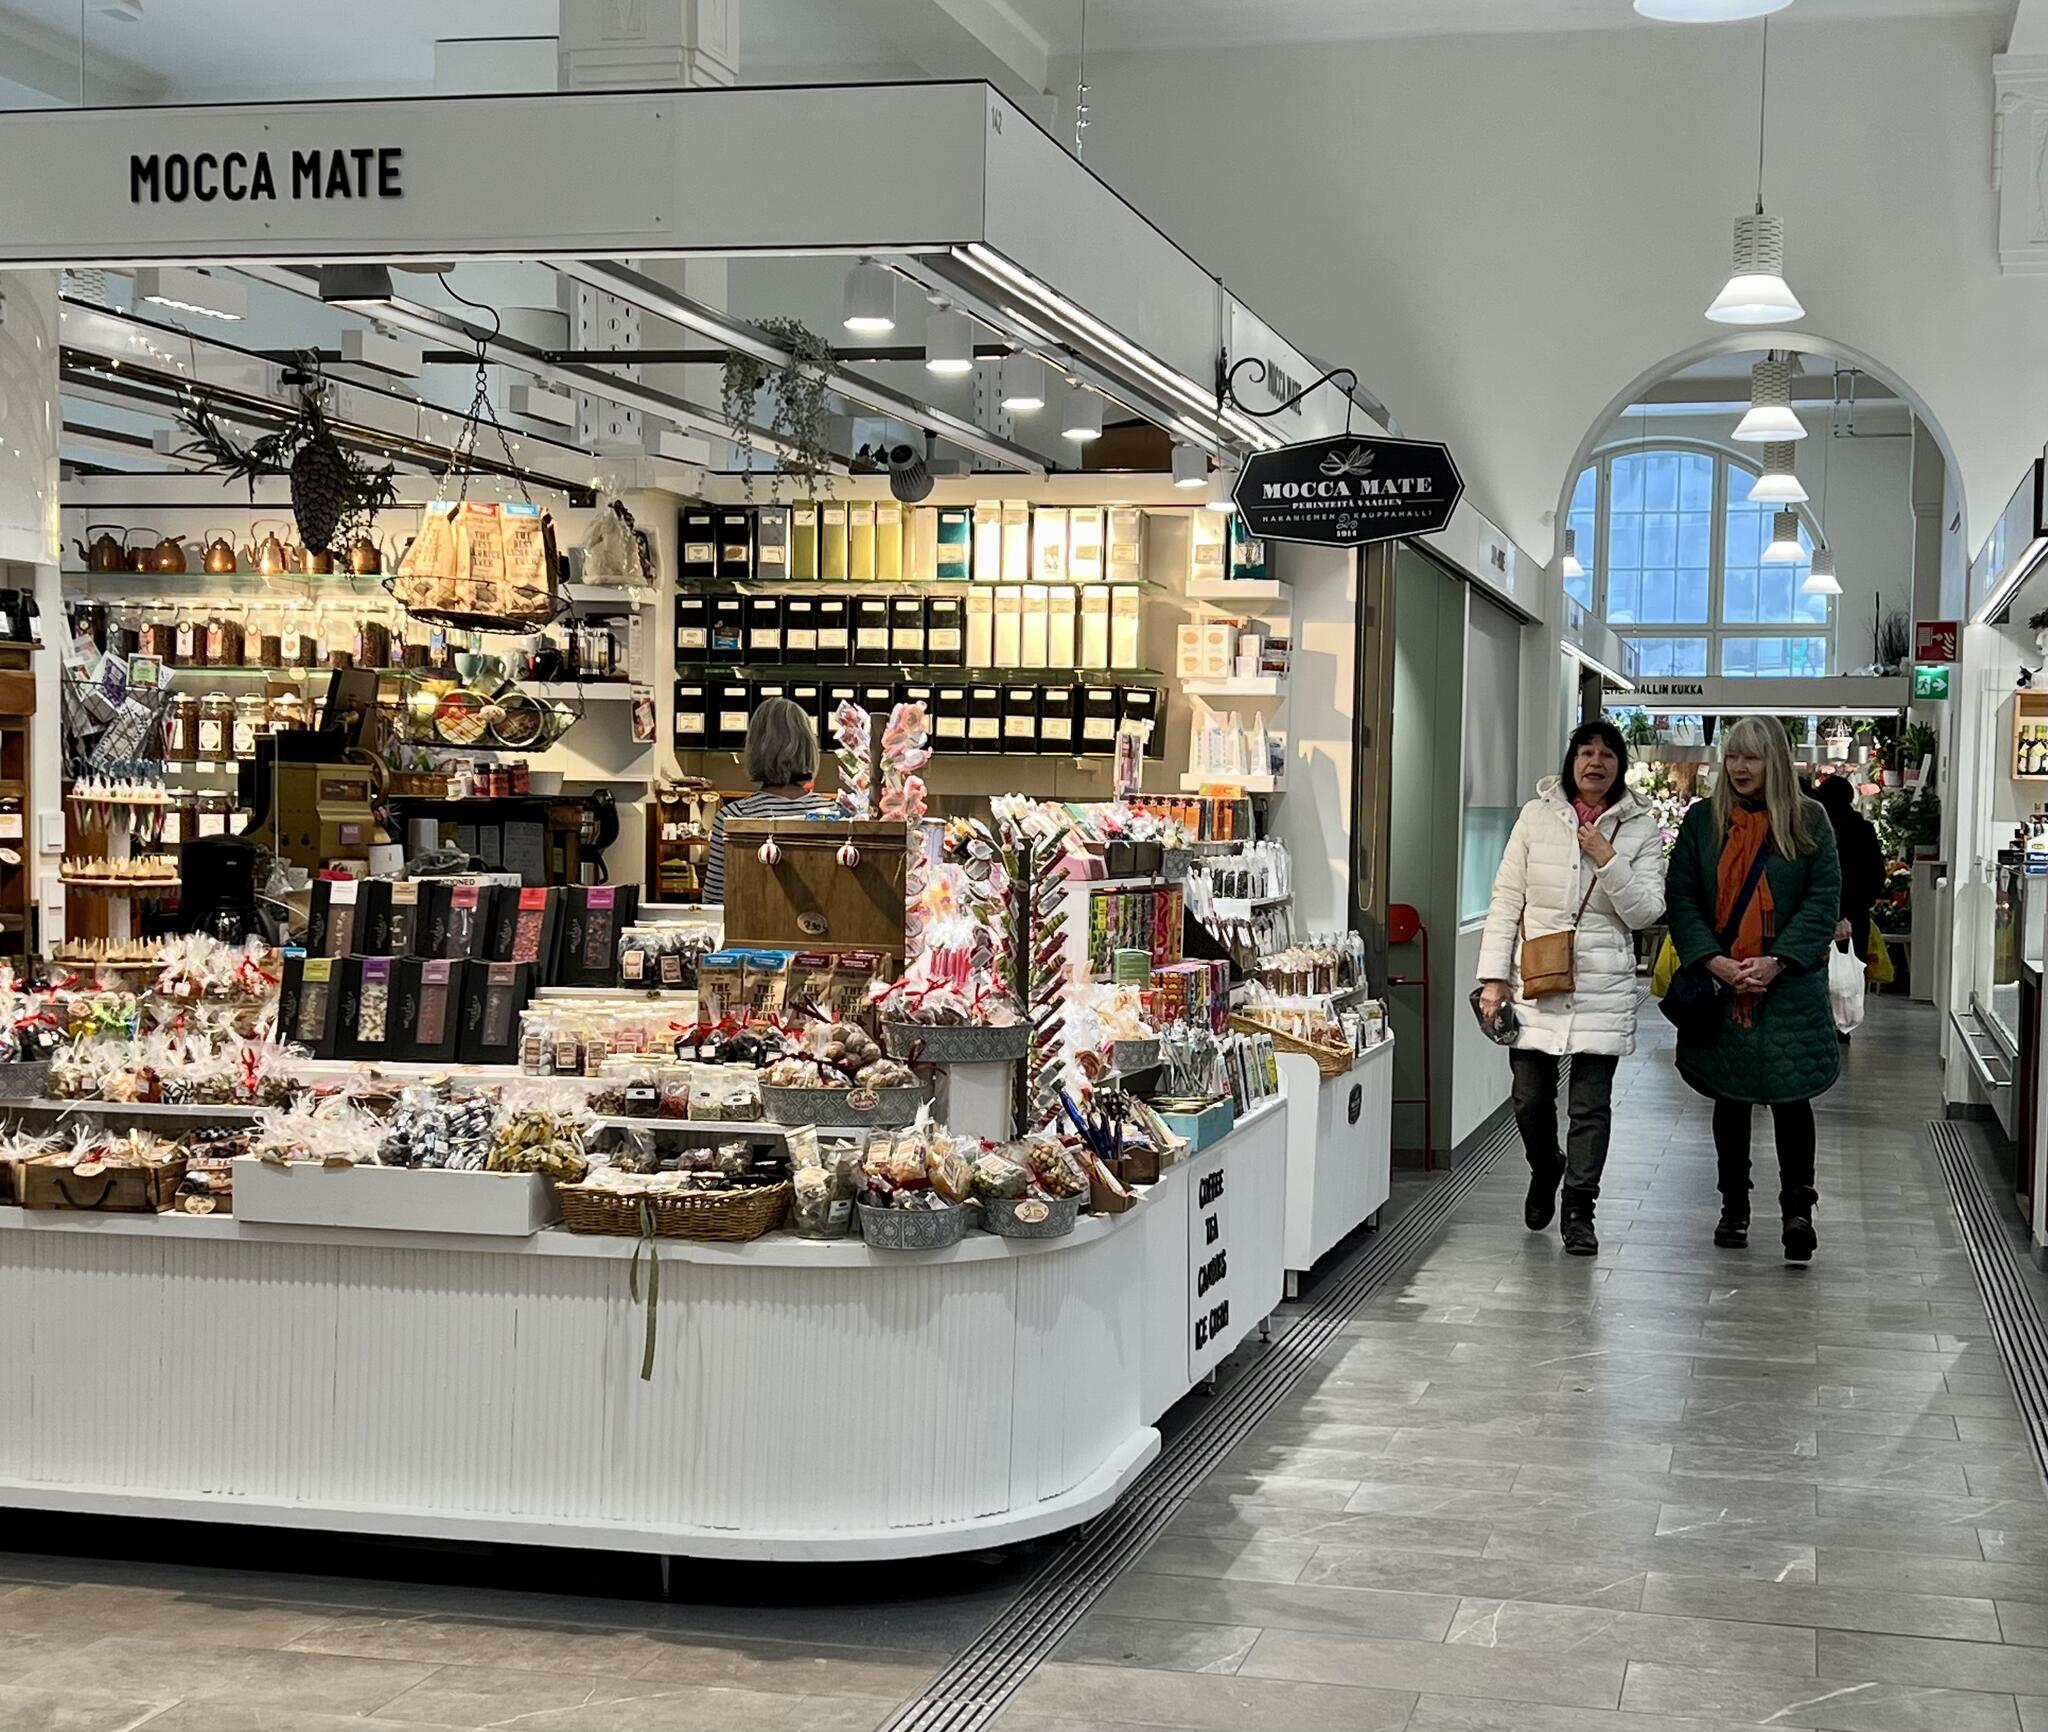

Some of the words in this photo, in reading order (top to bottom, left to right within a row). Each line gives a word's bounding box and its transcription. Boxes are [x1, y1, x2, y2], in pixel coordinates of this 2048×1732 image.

[130, 151, 277, 203] MOCCA
[292, 147, 403, 199] MATE
[1262, 481, 1351, 499] MOCCA
[1360, 477, 1432, 495] MATE
[1262, 513, 1336, 522] HAKANIEMEN
[1353, 510, 1433, 519] KAUPPAHALLI
[1671, 684, 1704, 695] KUKKA
[711, 983, 730, 992] THE
[757, 984, 775, 994] THE
[844, 986, 863, 996] THE
[1205, 1212, 1219, 1245] TEA
[1195, 1315, 1208, 1351] ICE
